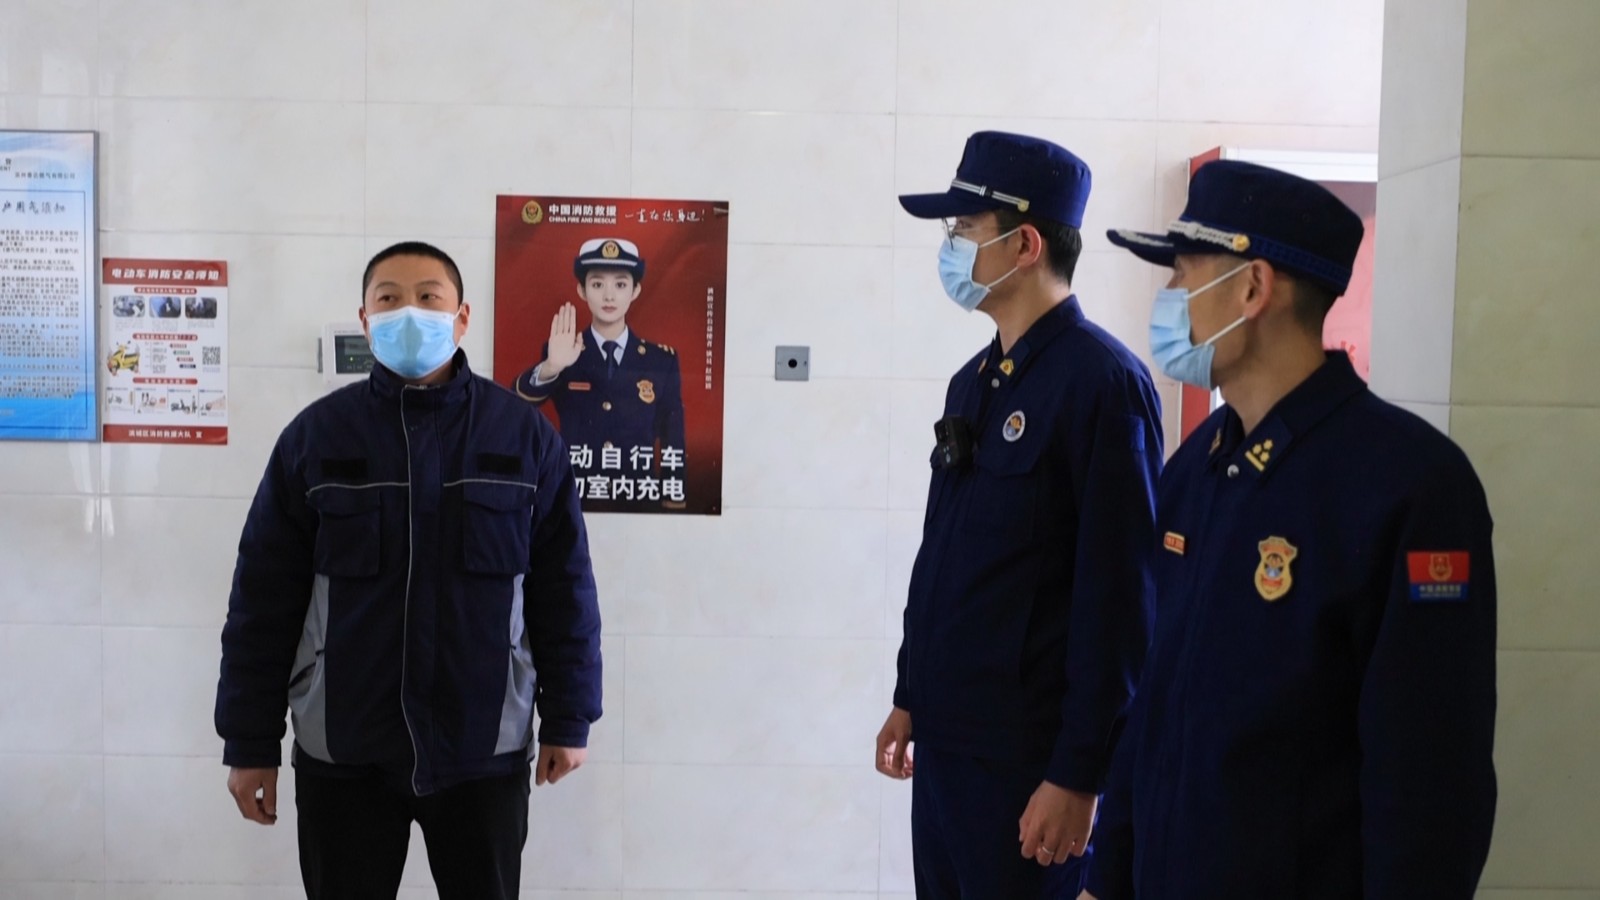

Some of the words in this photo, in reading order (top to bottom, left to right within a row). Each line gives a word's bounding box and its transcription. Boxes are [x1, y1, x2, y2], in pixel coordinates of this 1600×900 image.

[548, 203, 617, 217] 中国消防救援
[567, 216, 580, 224] FIRE
[593, 217, 617, 225] RESCUE
[111, 267, 219, 281] 电动车消防安全须知
[569, 444, 684, 471] 动自行车
